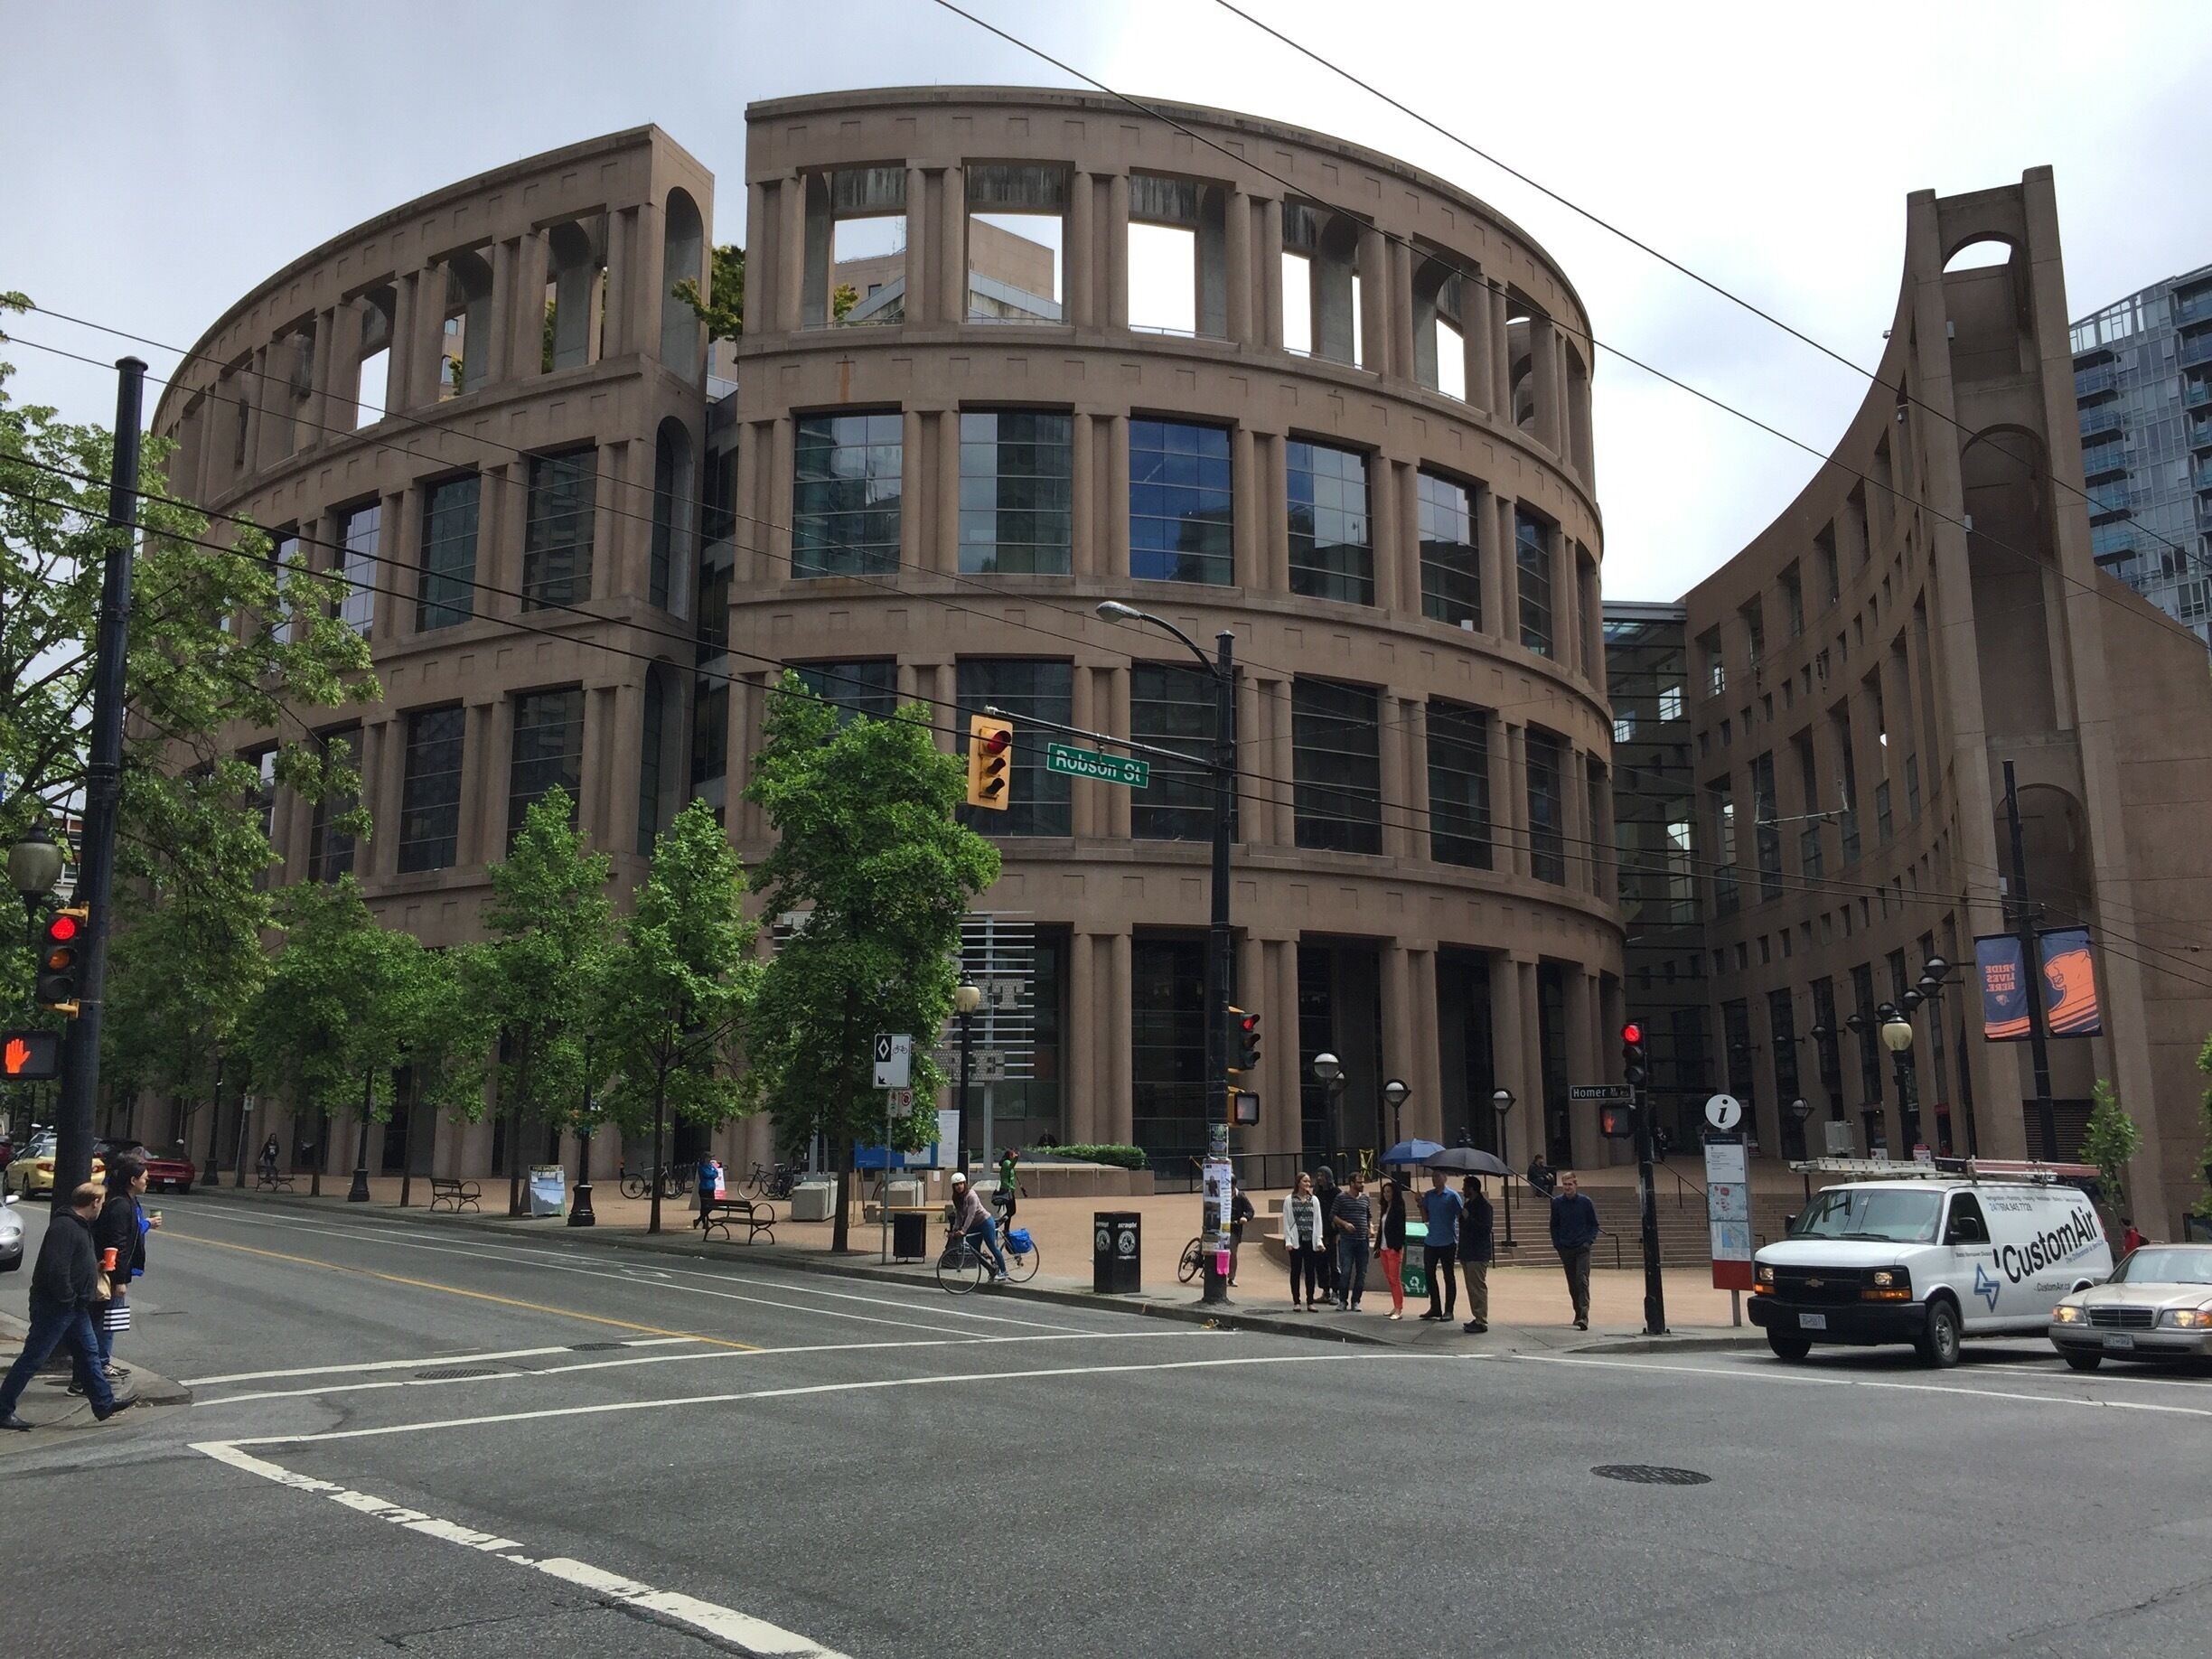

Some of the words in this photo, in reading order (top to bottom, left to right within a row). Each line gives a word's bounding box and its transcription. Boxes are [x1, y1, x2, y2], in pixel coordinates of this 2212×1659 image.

[1055, 750, 1117, 777] Robson
[1123, 764, 1140, 782] St
[1573, 1088, 1606, 1098] Homer
